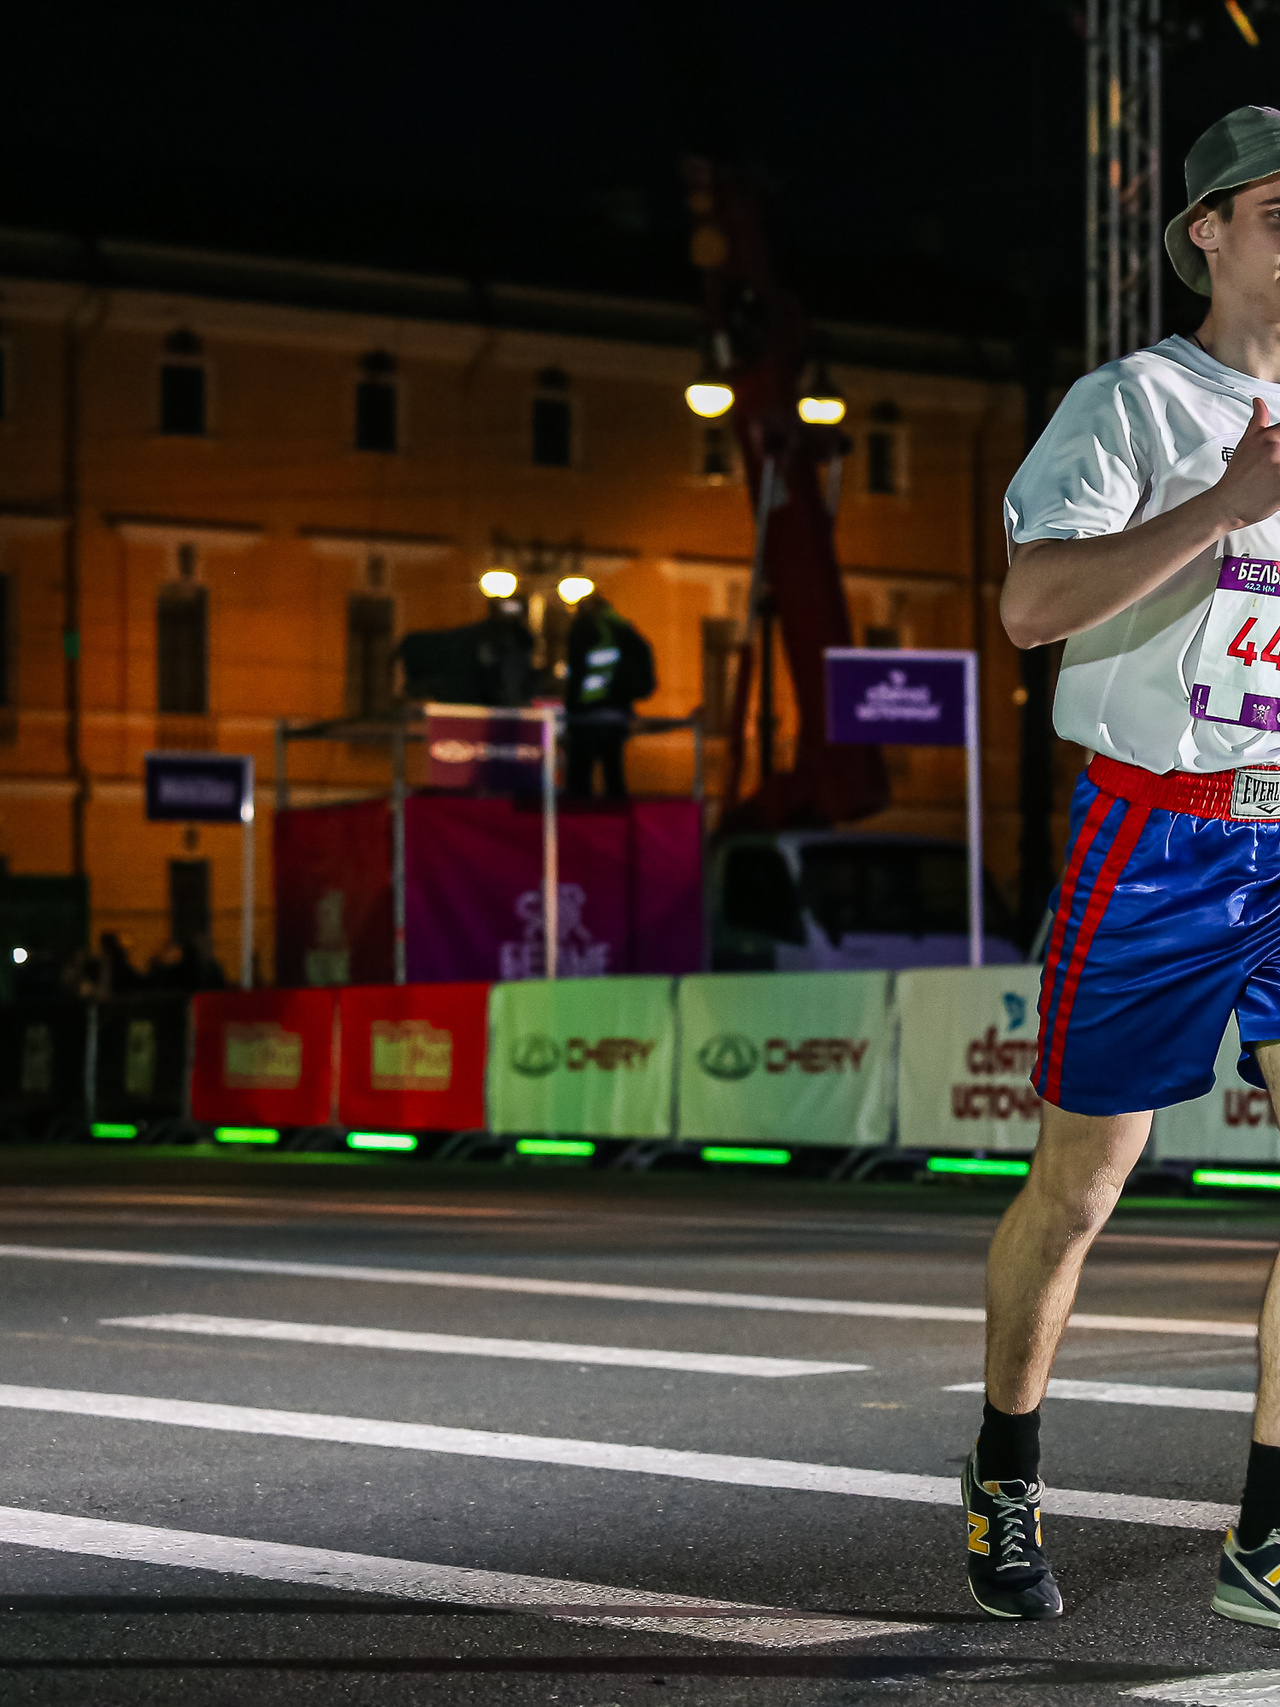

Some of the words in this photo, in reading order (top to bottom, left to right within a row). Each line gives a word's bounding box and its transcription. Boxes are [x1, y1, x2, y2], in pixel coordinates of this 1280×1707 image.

[1244, 583, 1261, 592] 42,2
[565, 1038, 655, 1072] CHERY
[764, 1038, 870, 1074] CHERY
